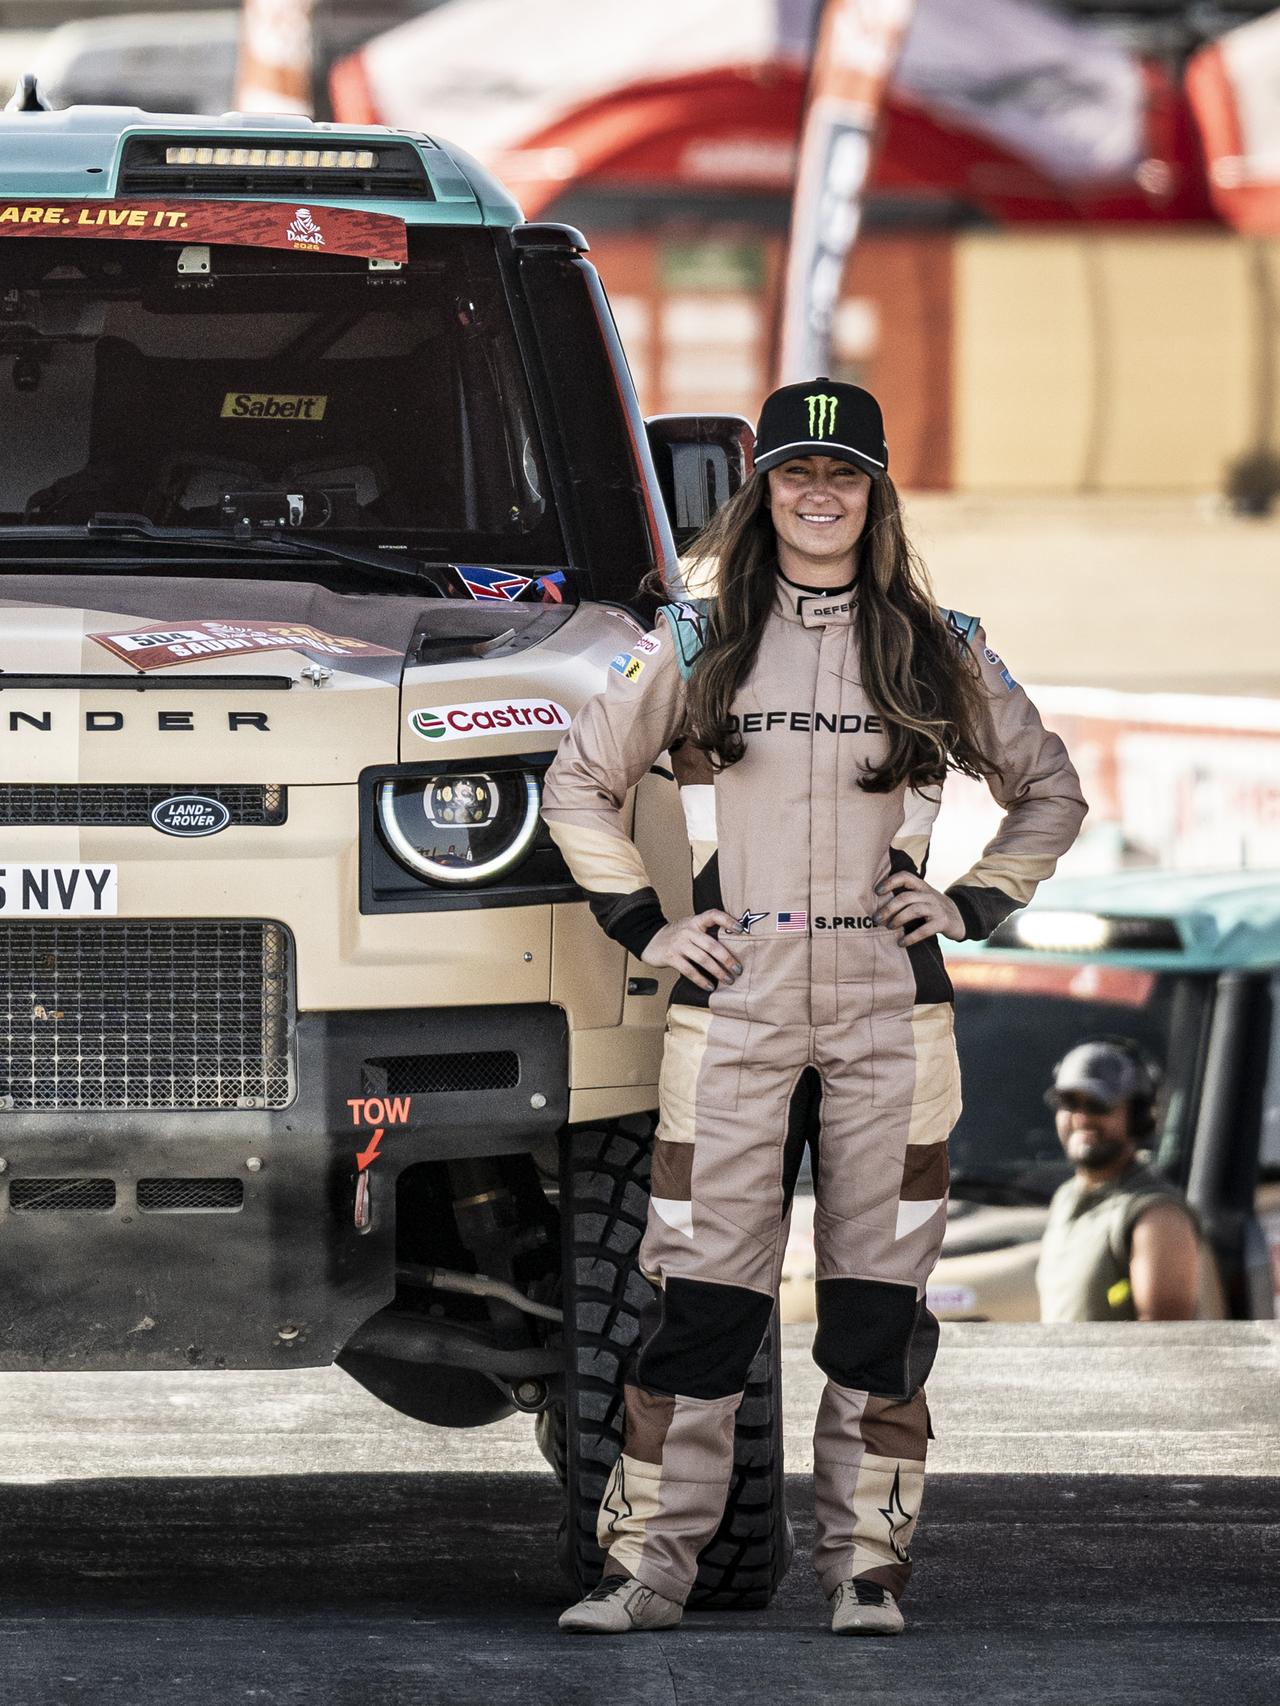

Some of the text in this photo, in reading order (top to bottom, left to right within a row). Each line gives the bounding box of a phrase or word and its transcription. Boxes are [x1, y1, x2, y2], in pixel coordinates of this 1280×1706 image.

[78, 209, 148, 227] LIVE
[153, 211, 189, 228] IT.
[286, 229, 325, 245] DAKAR
[231, 395, 316, 418] Sabelt
[129, 631, 193, 647] 504
[168, 637, 253, 657] SAUDI
[447, 704, 564, 732] Castrol
[726, 711, 883, 734] DEFENDE
[168, 804, 204, 815] LAND
[171, 815, 215, 826] ROVER
[22, 868, 111, 910] NVY
[346, 1096, 411, 1125] TOW
